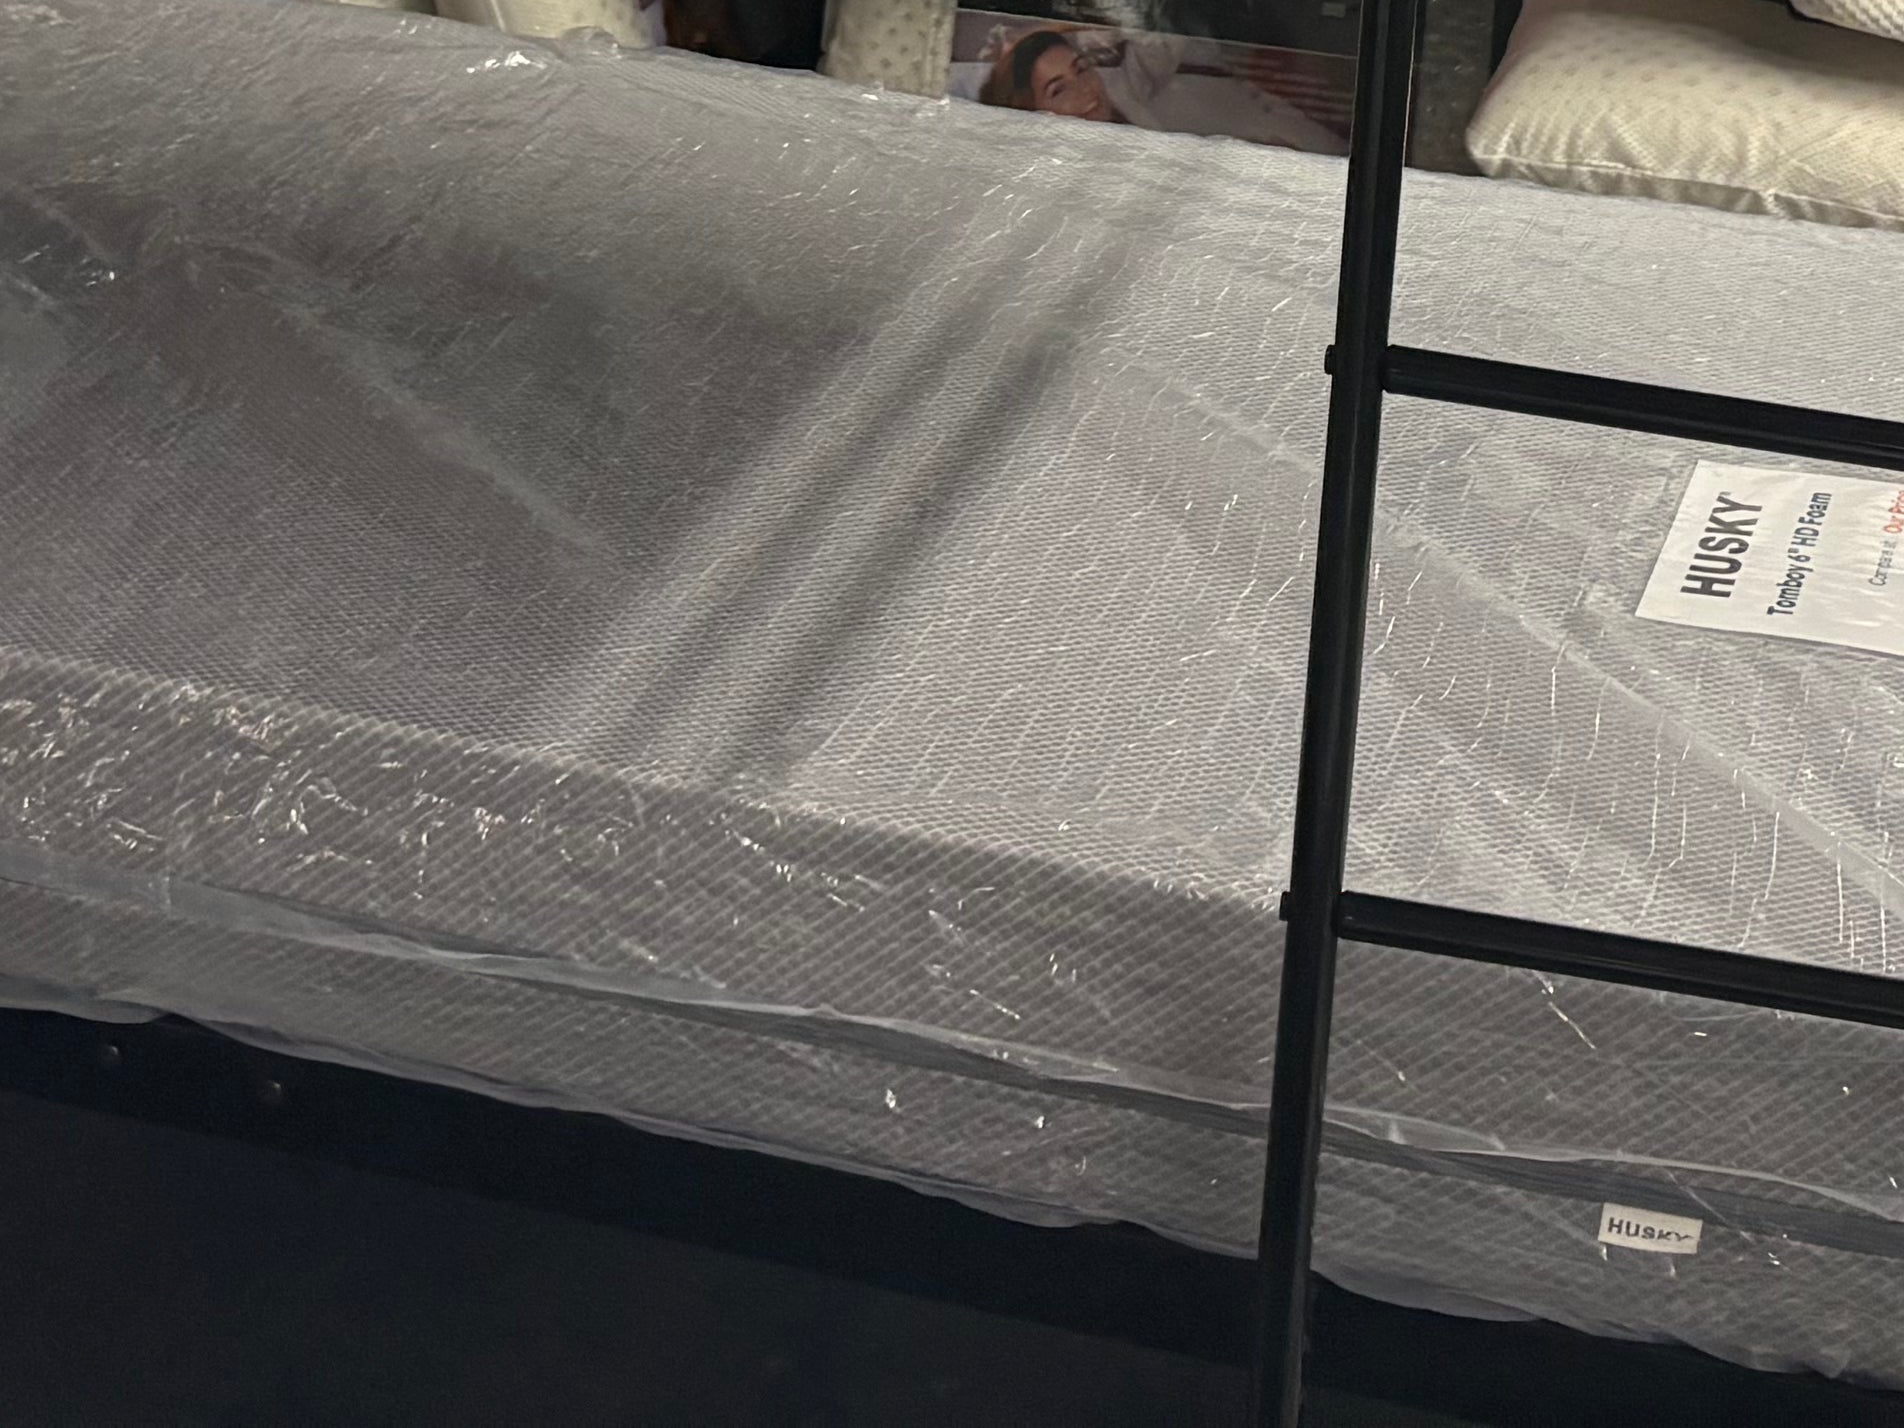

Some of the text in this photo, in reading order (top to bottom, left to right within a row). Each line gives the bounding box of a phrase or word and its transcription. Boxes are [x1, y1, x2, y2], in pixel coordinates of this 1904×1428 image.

[1798, 492, 1833, 526] Foam
[1791, 527, 1819, 547] HD
[1766, 564, 1814, 615] Tomboy
[1607, 1216, 1695, 1242] HUSKY
